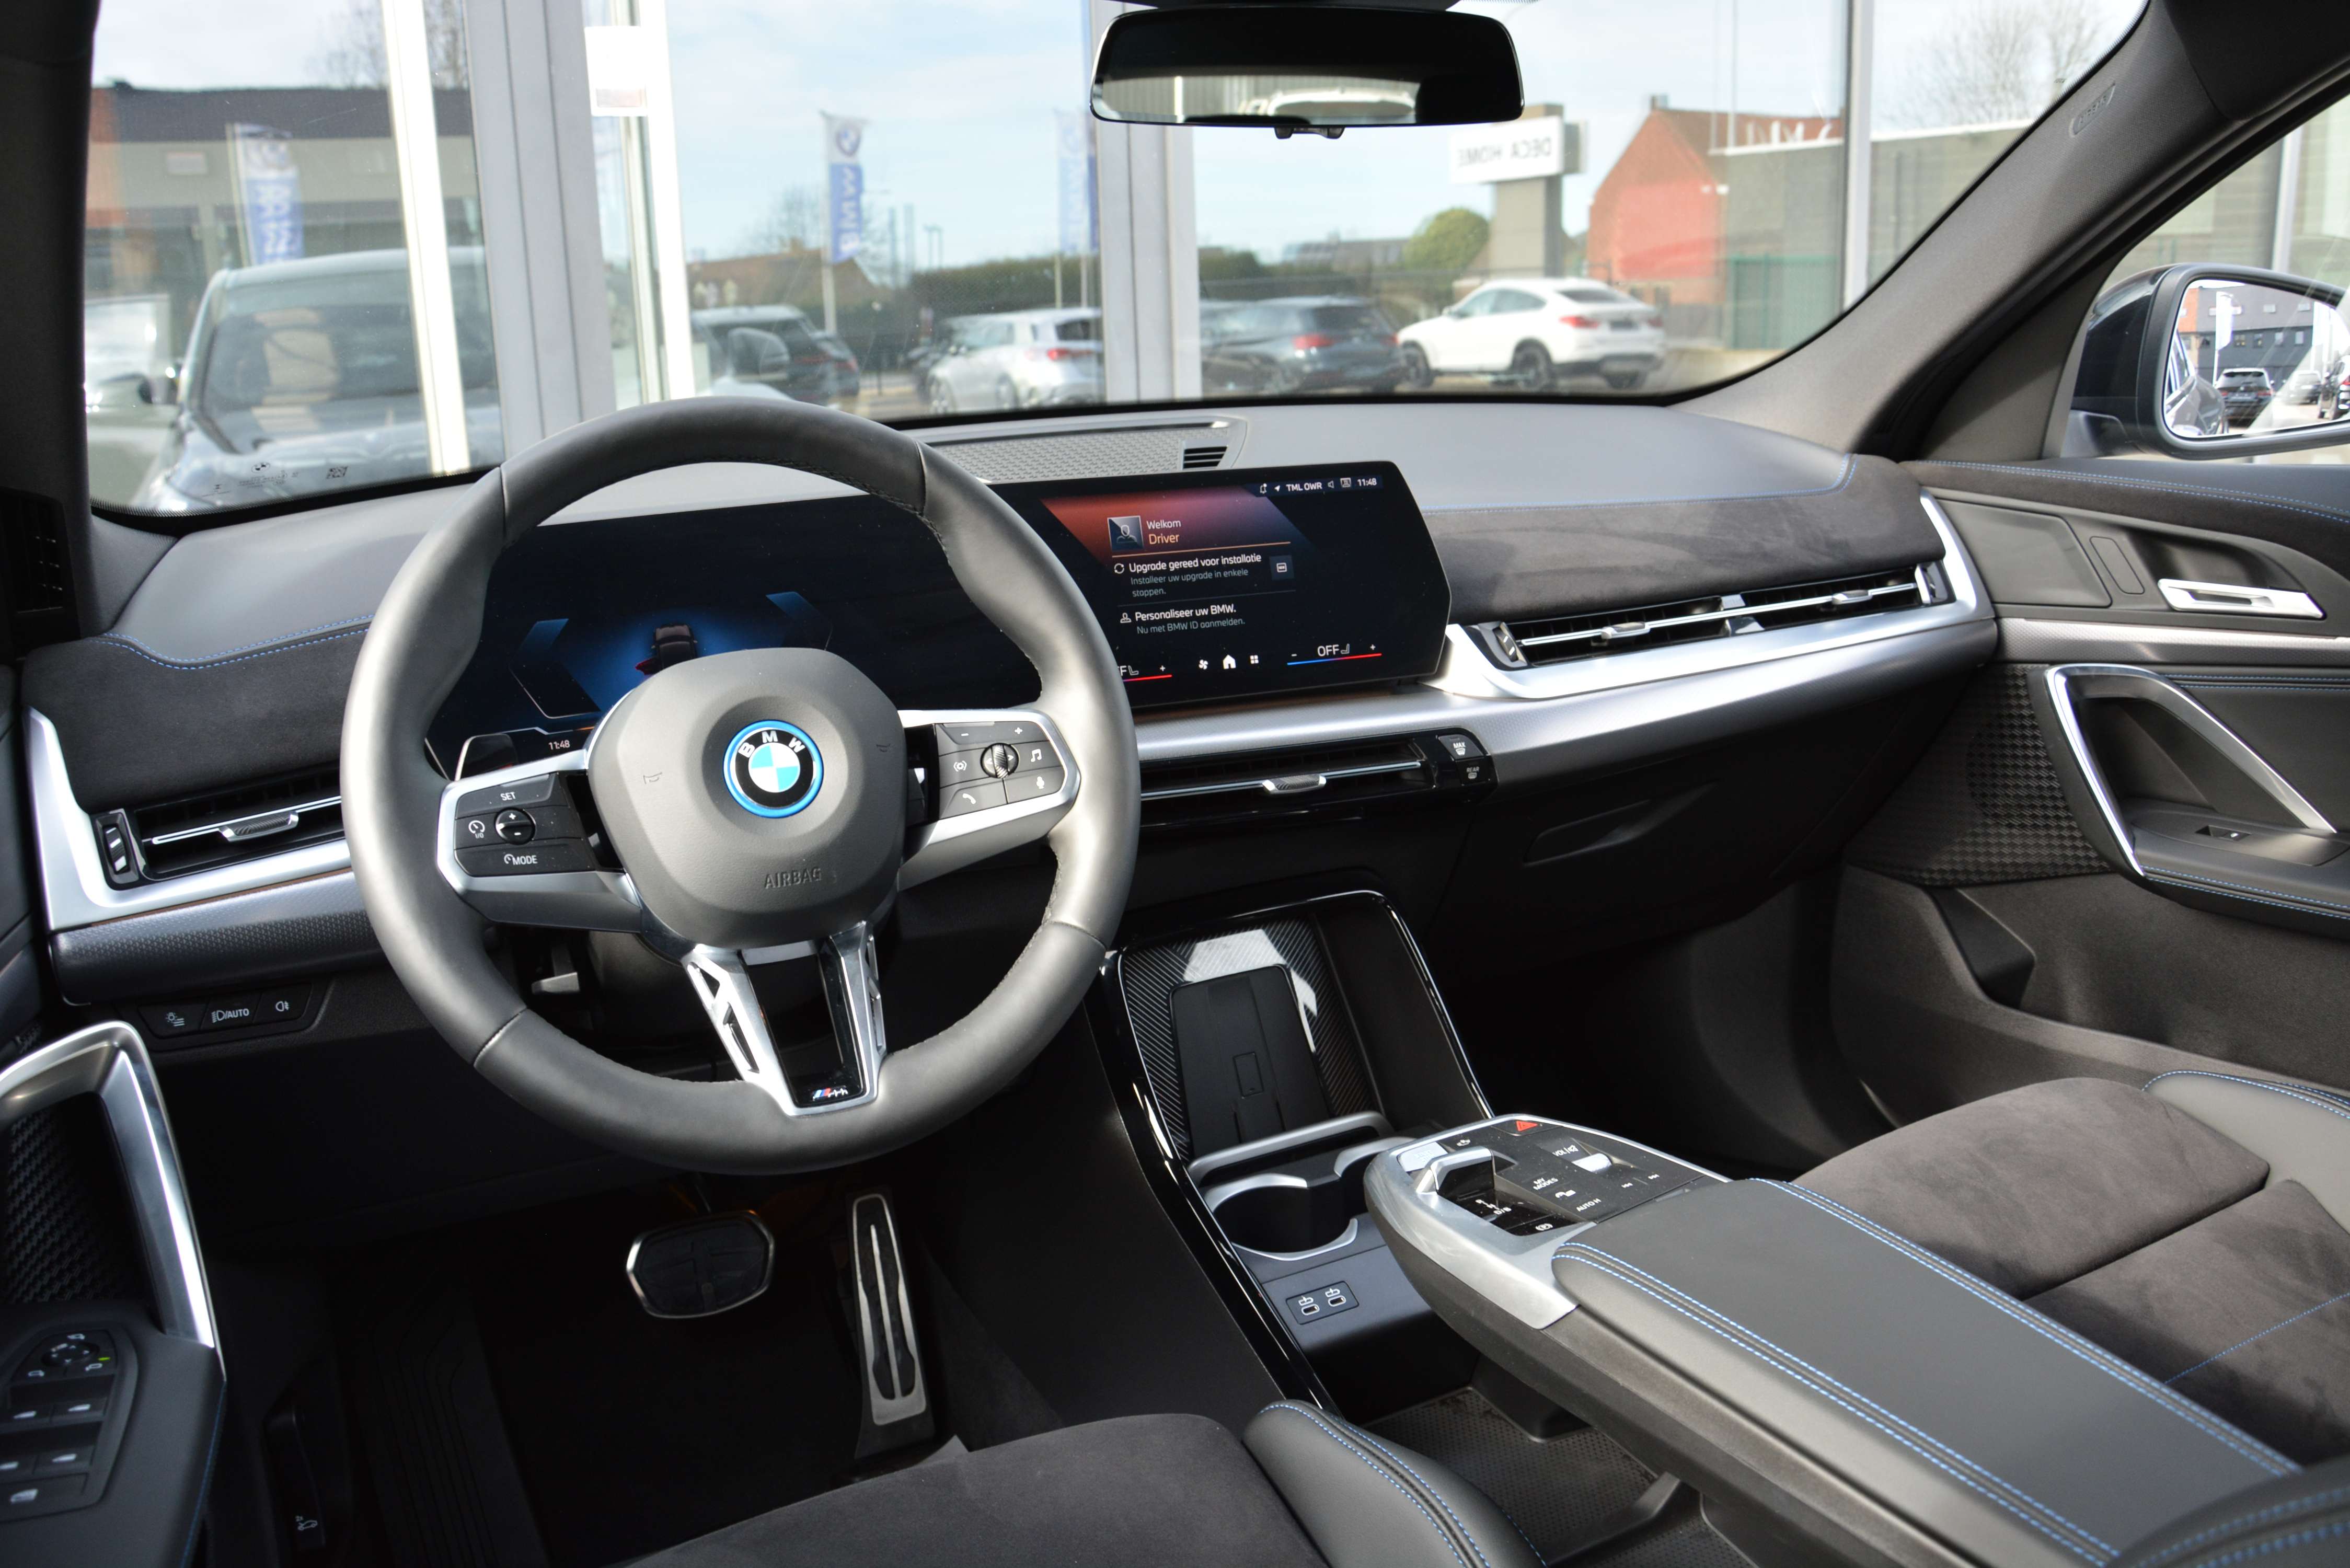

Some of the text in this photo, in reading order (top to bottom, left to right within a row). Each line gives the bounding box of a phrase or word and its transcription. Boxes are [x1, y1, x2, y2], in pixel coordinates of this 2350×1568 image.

[1304, 482, 1322, 491] OWR
[1357, 478, 1377, 487] 11:48
[1147, 520, 1181, 529] Welkom
[1149, 533, 1180, 545] Driver
[1129, 553, 1262, 574] Upgrade gereed voor installatie
[1131, 573, 1166, 585] Installeer
[1181, 571, 1213, 582] upgrade
[1214, 569, 1222, 578] in
[1223, 568, 1249, 578] enkele
[1135, 604, 1236, 621] Personaliseer uw BMW.
[1137, 617, 1246, 635] Nu met BMW ID aanmelden.
[1317, 644, 1340, 657] OFF
[549, 740, 570, 750] 11:48
[738, 730, 806, 758] BMW
[500, 791, 516, 801] SET
[512, 855, 538, 866] MODE
[765, 868, 822, 890] AIRBAG
[1533, 1178, 1559, 1190] MODES
[1576, 1201, 1596, 1212] AUTO
